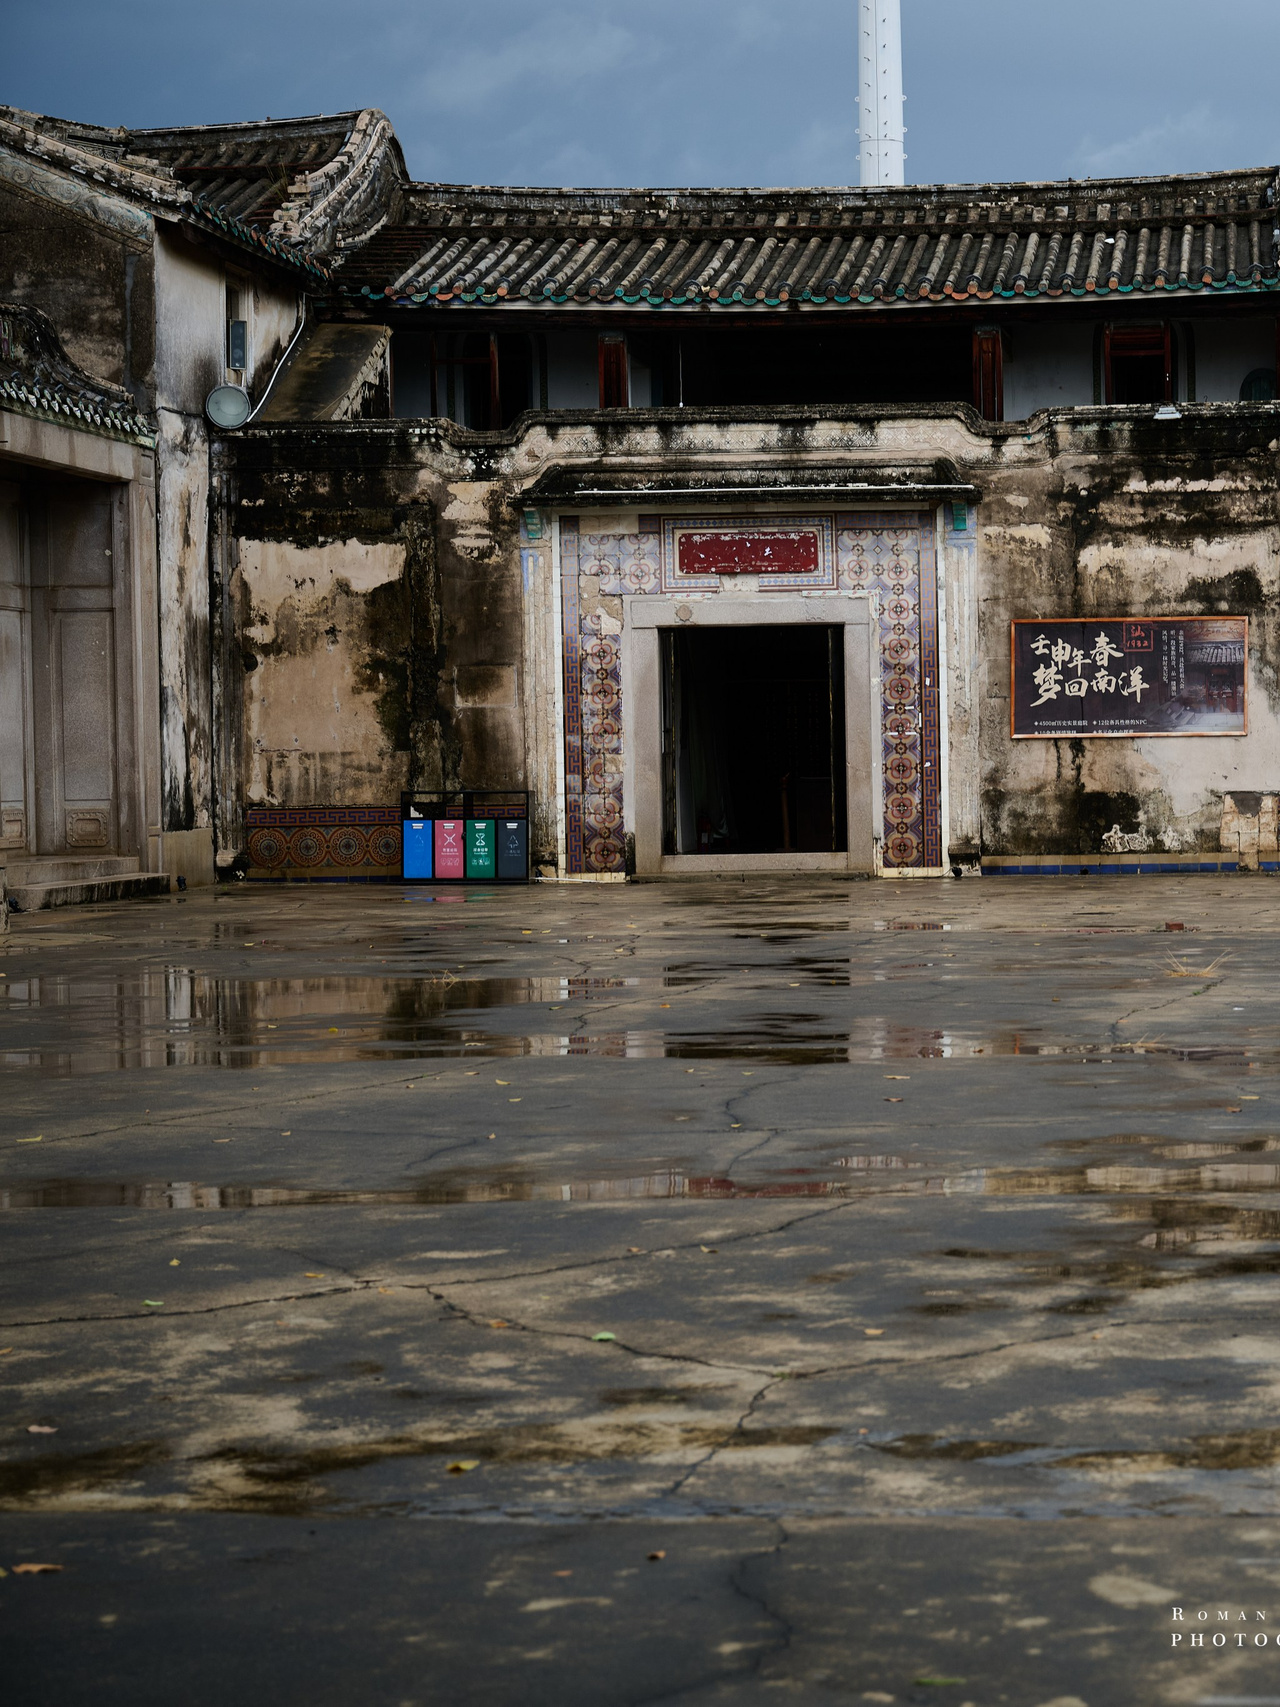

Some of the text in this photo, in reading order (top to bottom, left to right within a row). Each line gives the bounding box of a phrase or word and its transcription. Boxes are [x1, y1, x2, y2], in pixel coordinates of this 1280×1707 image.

[1127, 639, 1149, 648] 1932
[1131, 625, 1145, 637] 汕
[1030, 631, 1125, 676] 壬申年春
[1030, 661, 1150, 707] 梦回南洋
